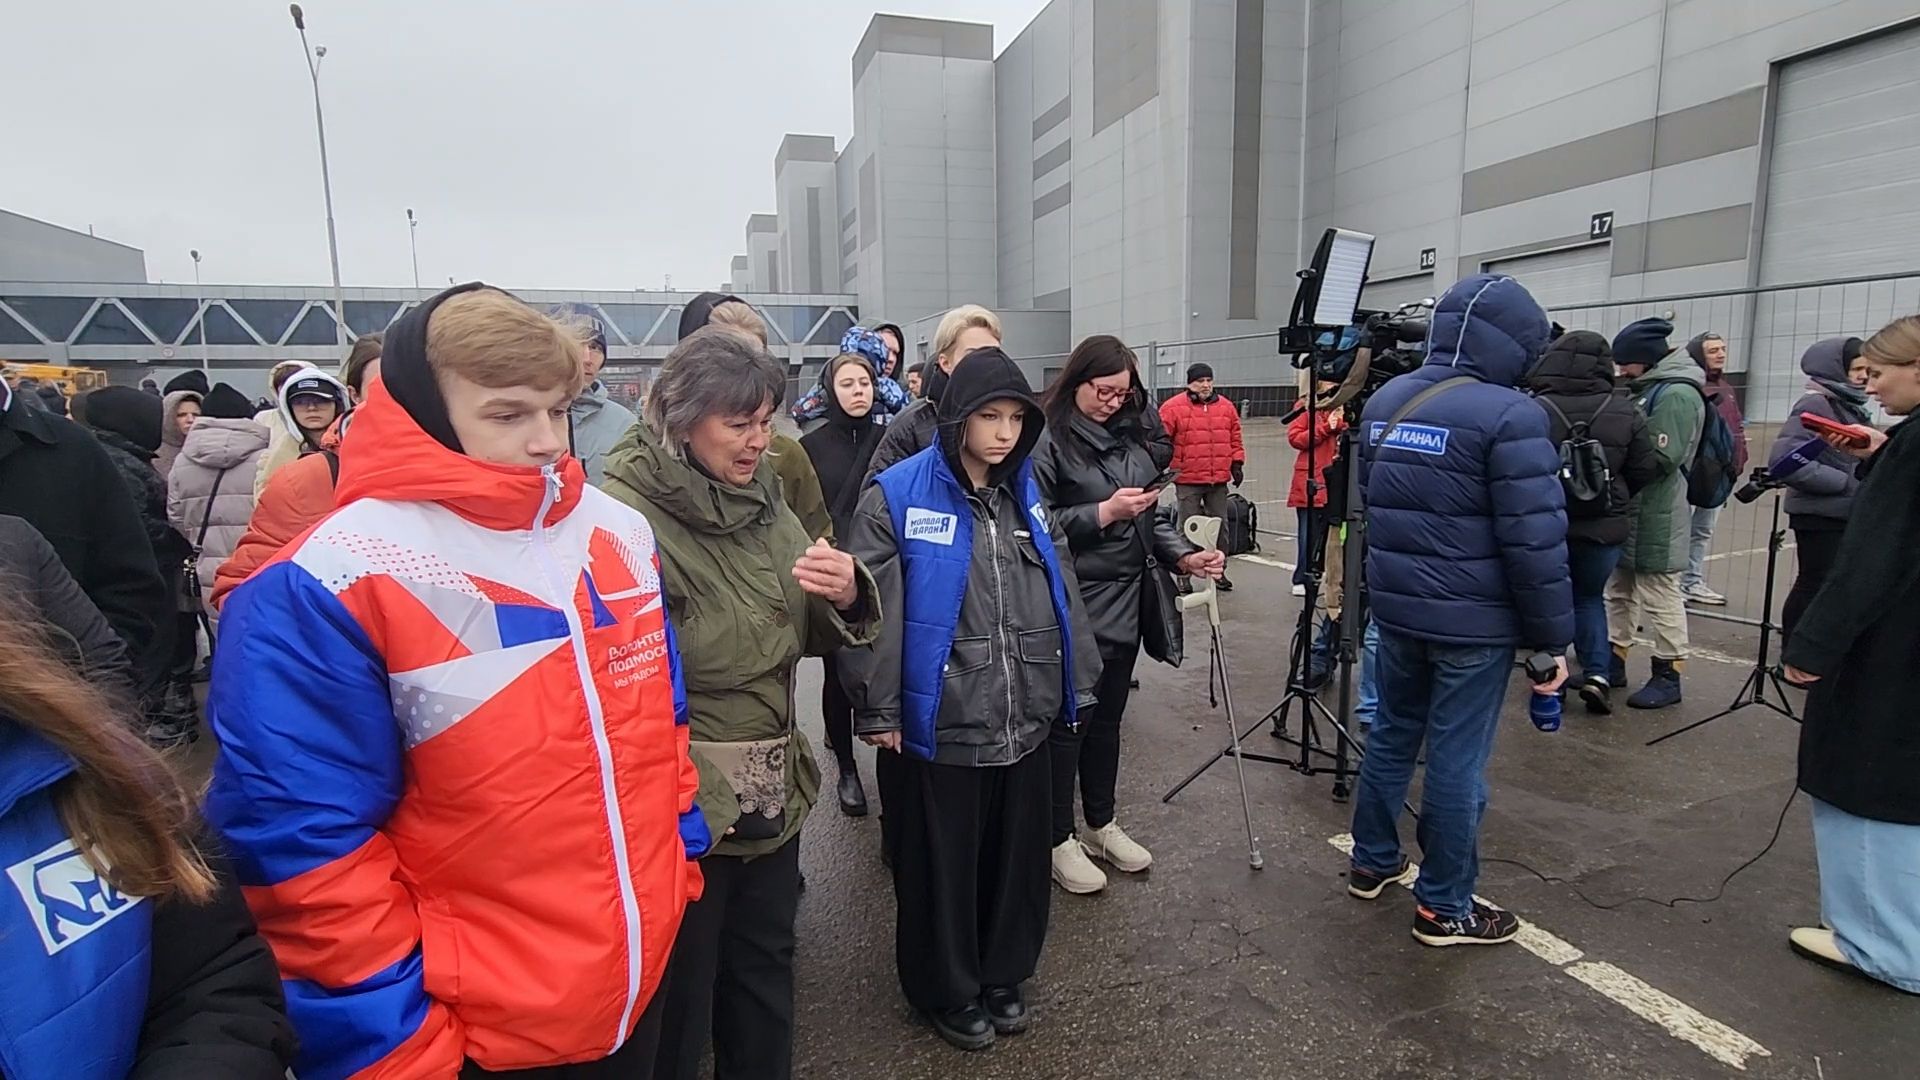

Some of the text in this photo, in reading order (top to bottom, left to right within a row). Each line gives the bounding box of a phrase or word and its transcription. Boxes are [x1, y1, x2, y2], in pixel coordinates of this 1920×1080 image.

[1592, 216, 1612, 234] 17
[1421, 252, 1435, 266] 18
[1401, 430, 1441, 448] КАНАЛ
[629, 665, 659, 684] РЯДОМ
